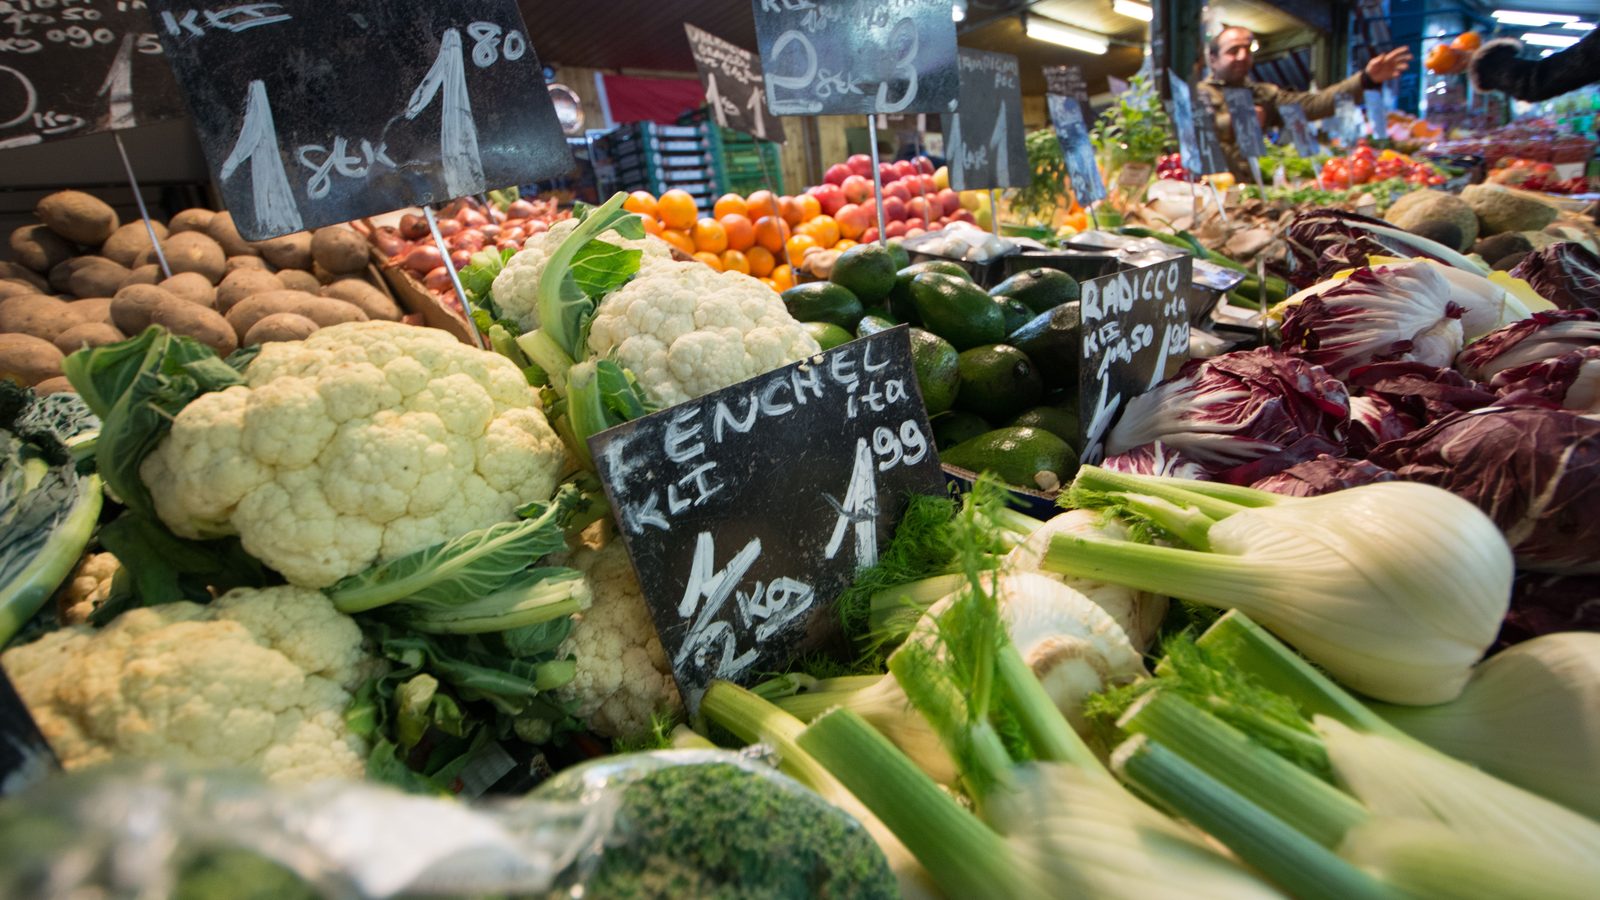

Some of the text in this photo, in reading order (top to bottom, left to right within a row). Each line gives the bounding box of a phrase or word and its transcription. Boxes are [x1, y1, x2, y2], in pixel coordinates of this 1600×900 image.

[875, 16, 919, 113] 3
[1081, 262, 1180, 325] RADICCO
[605, 341, 891, 495] FENCHEL
[846, 378, 910, 418] ita
